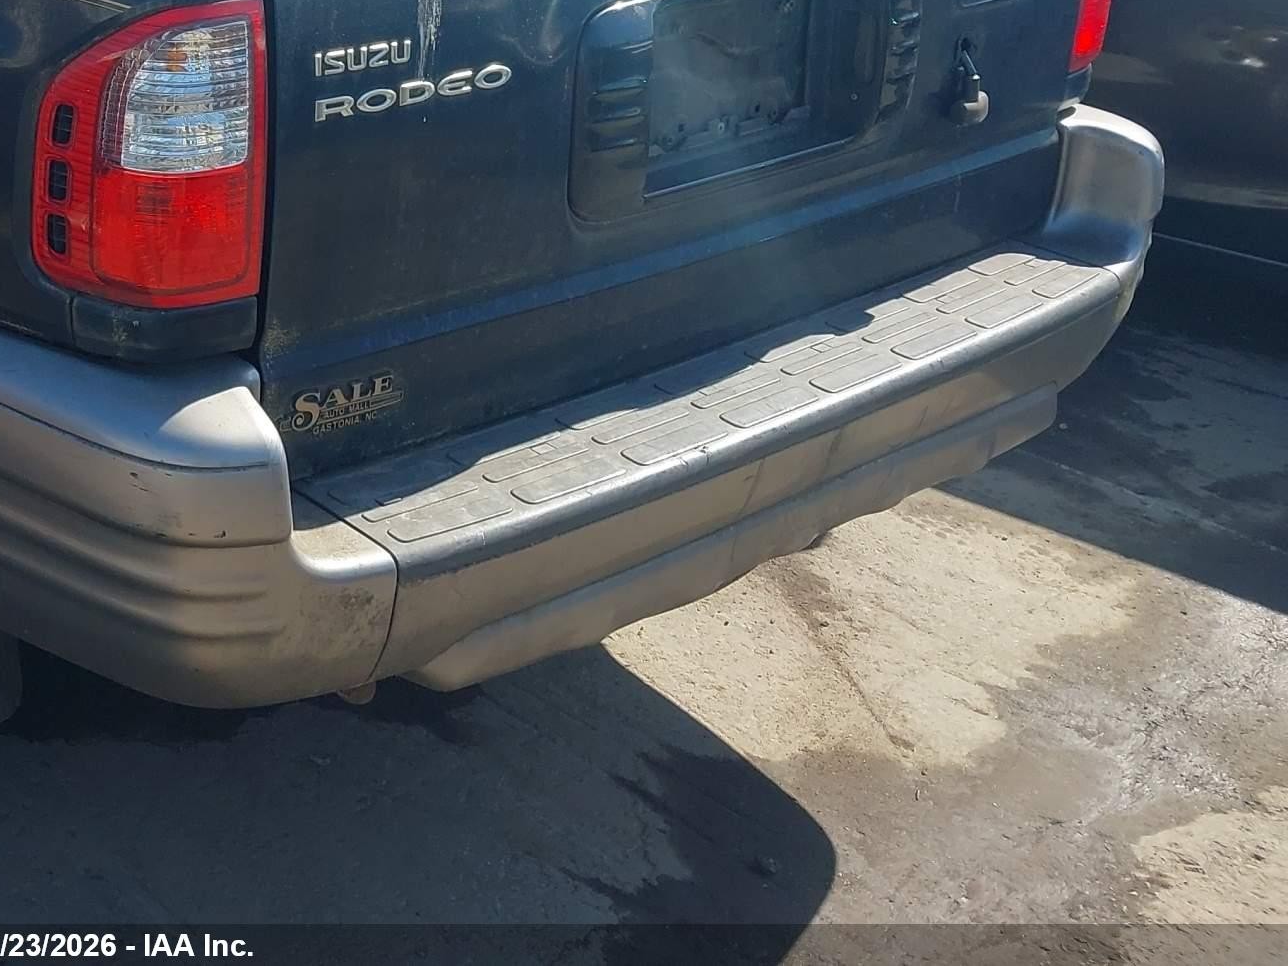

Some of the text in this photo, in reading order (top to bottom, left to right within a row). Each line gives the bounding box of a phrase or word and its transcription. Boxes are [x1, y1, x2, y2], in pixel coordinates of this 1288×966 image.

[313, 38, 413, 78] ISUZU
[314, 63, 513, 123] RODEO
[291, 372, 395, 432] SALE
[325, 401, 370, 419] AUTO MALL
[365, 411, 378, 422] NC
